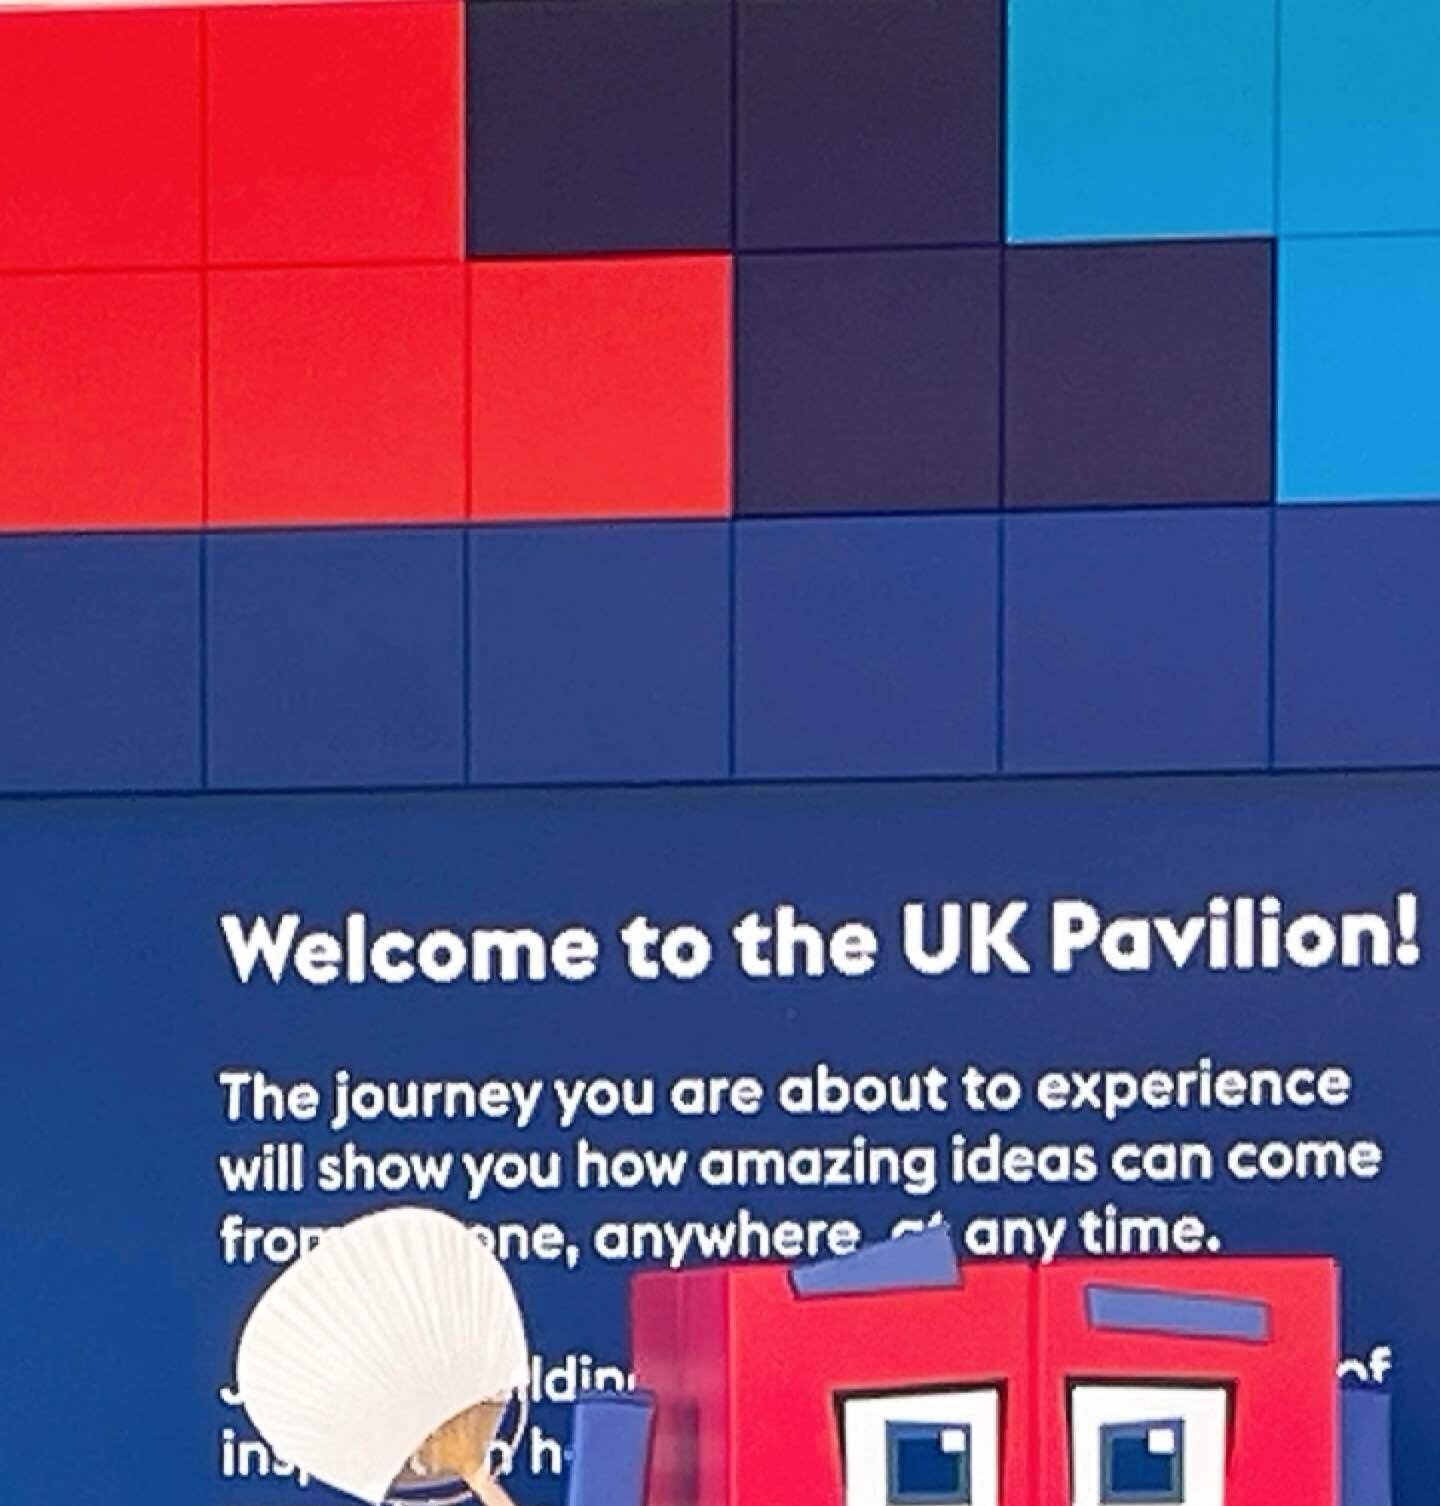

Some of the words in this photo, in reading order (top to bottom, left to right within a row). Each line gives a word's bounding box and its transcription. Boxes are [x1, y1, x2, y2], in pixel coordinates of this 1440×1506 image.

[221, 913, 598, 984] Welcome
[621, 917, 711, 979] to
[733, 905, 877, 976] the
[904, 901, 1030, 973] UK
[1053, 893, 1419, 971] Pavilion!
[220, 1072, 319, 1120] The
[332, 1071, 542, 1129] journey
[554, 1079, 653, 1127] you
[671, 1077, 763, 1113] are
[780, 1064, 947, 1113] about
[962, 1067, 1021, 1110] to
[1038, 1058, 1350, 1119] experience
[220, 1143, 303, 1191] will
[319, 1142, 453, 1190] show
[462, 1152, 560, 1199] you
[578, 1138, 687, 1187] how
[700, 1135, 936, 1195] amazing
[952, 1134, 1097, 1182] ideas
[1112, 1144, 1212, 1181] can
[1228, 1141, 1382, 1178] come
[965, 1217, 1067, 1265] any
[1079, 1204, 1221, 1254] time.
